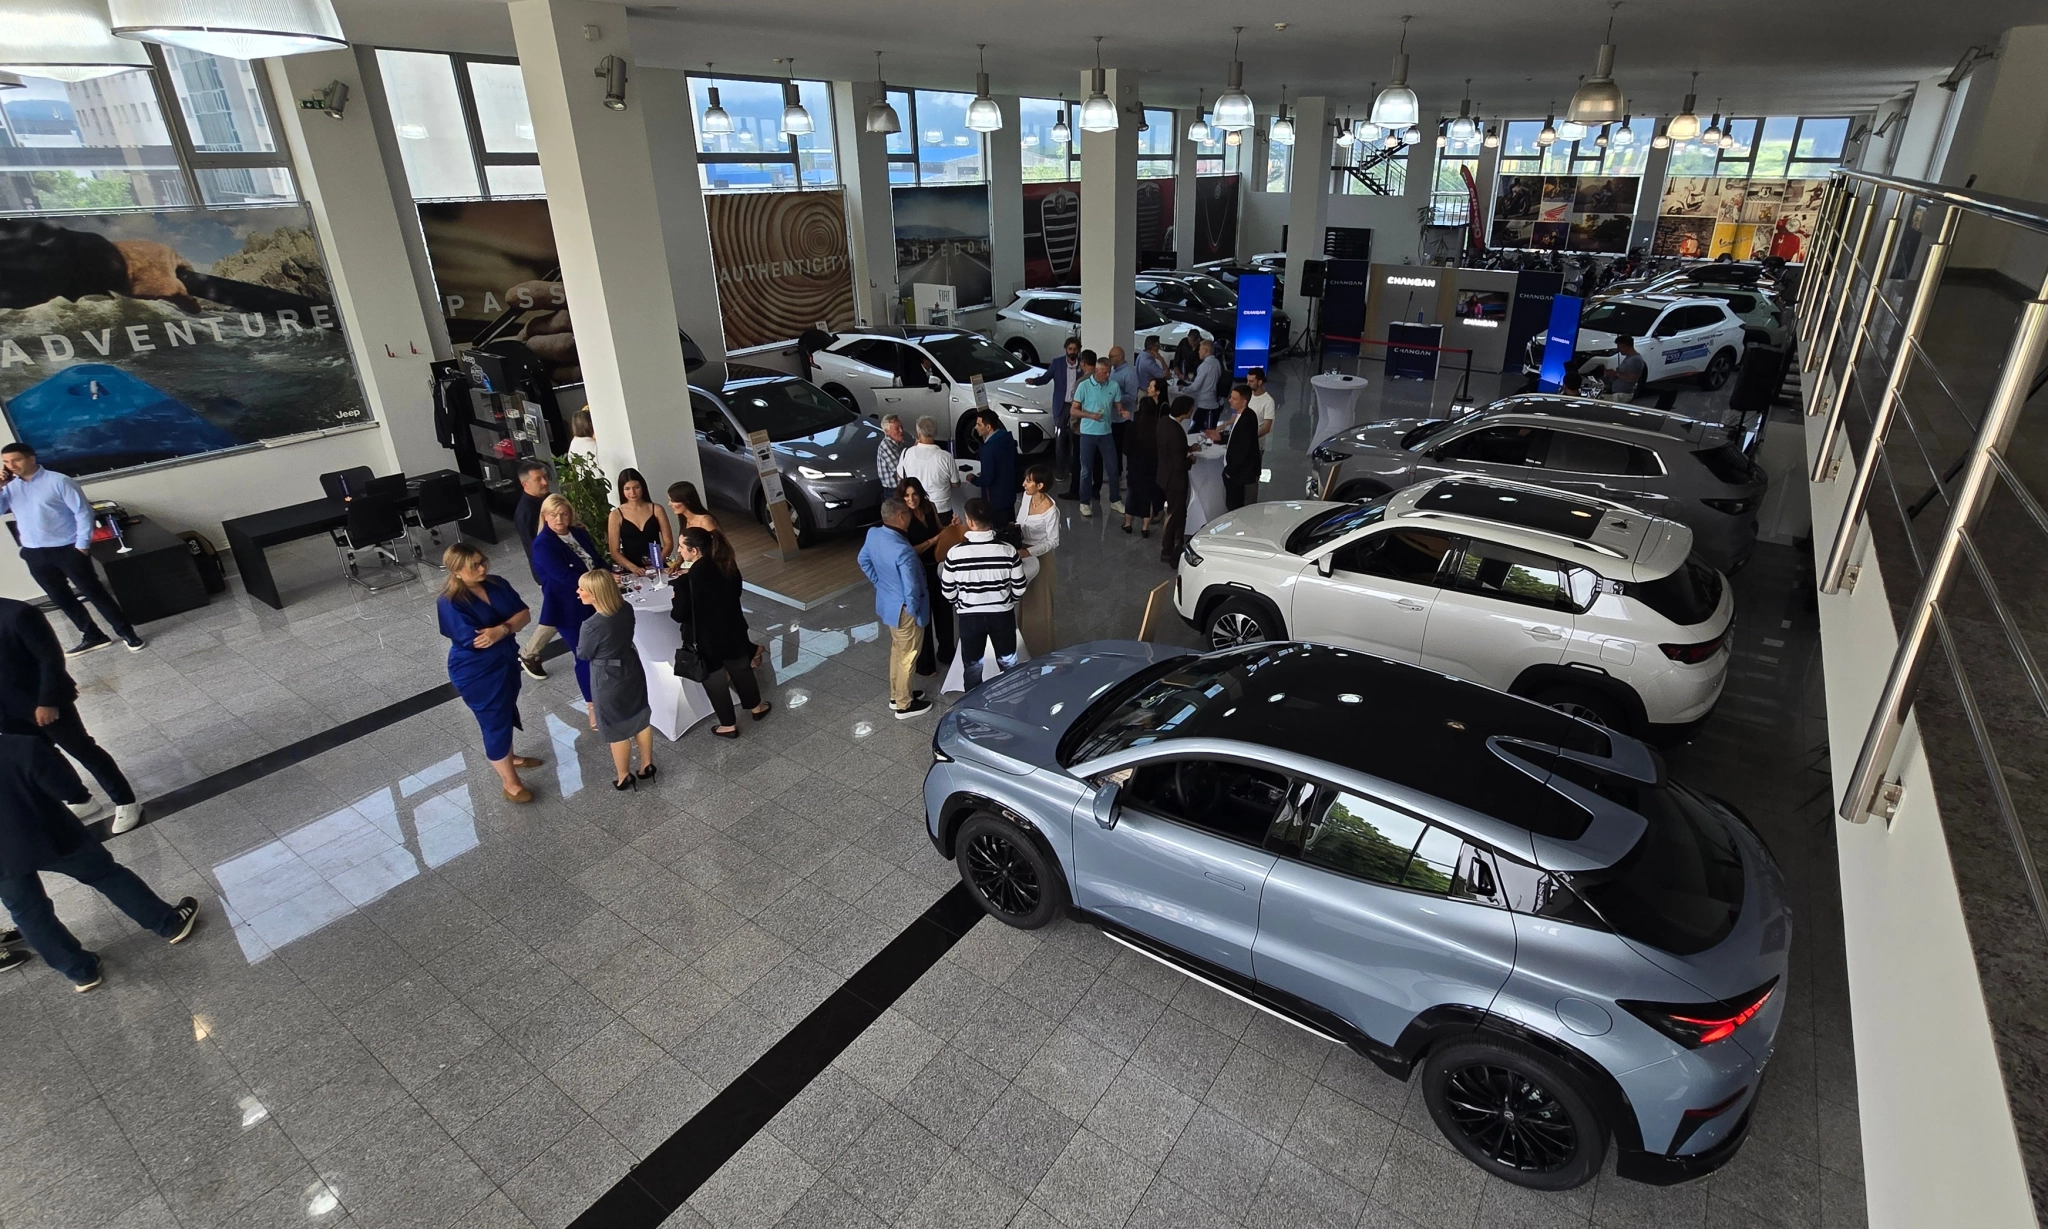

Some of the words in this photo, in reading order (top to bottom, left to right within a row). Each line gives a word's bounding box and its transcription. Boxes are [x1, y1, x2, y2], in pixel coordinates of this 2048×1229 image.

[897, 239, 989, 264] FREEDOM
[720, 255, 848, 284] AUTHENTICITY
[1387, 276, 1436, 287] CHANGAN
[939, 290, 950, 302] FIAT
[2, 305, 334, 368] ADVENTURE
[461, 352, 475, 365] Jeep
[336, 409, 360, 419] Jeep
